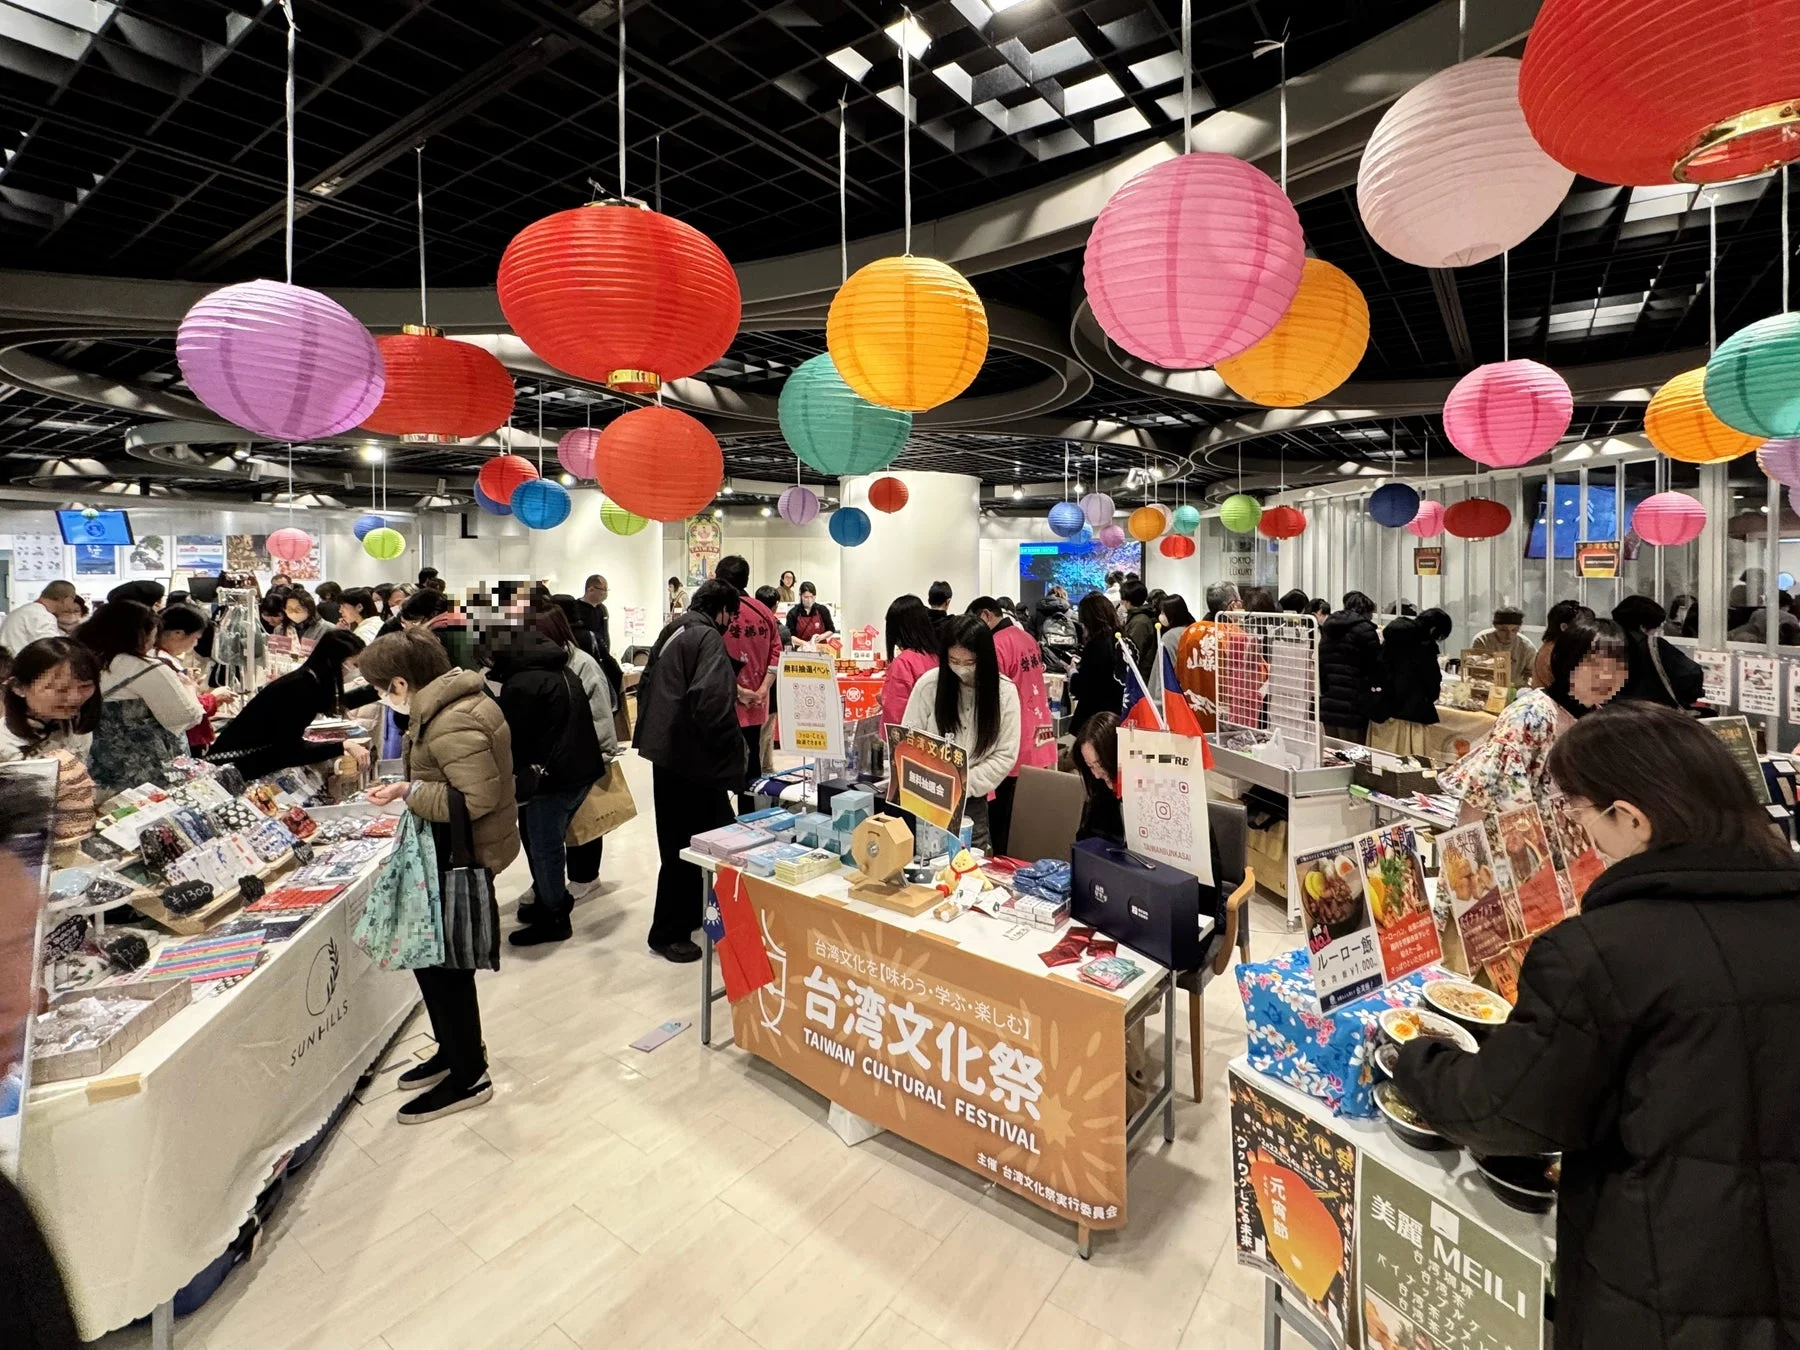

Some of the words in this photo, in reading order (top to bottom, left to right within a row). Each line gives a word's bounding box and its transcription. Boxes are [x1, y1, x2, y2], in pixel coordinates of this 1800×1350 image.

[783, 664, 831, 676] 無料抽選イベント
[905, 730, 964, 767] 台湾文化祭
[908, 770, 945, 798] 無料抽選会
[1317, 934, 1374, 972] ルーロー飯
[814, 938, 1031, 1041] 台湾文化を【味わう・学ぶ・楽しむ】
[802, 964, 1044, 1121] 台湾文化祭
[803, 1028, 856, 1068] TAIWAN
[861, 1056, 947, 1110] CULTURAL
[954, 1099, 1041, 1155] FESTIVAL
[976, 1151, 998, 1173] 主催
[1002, 1164, 1118, 1221] 台湾文化祭実行委員会
[1270, 1176, 1289, 1240] 元宵節
[1371, 1194, 1424, 1250] 美麗
[1433, 1234, 1526, 1319] MEILI
[1413, 1249, 1474, 1300] 台湾珈琲
[1421, 1270, 1466, 1309] 台湾茶
